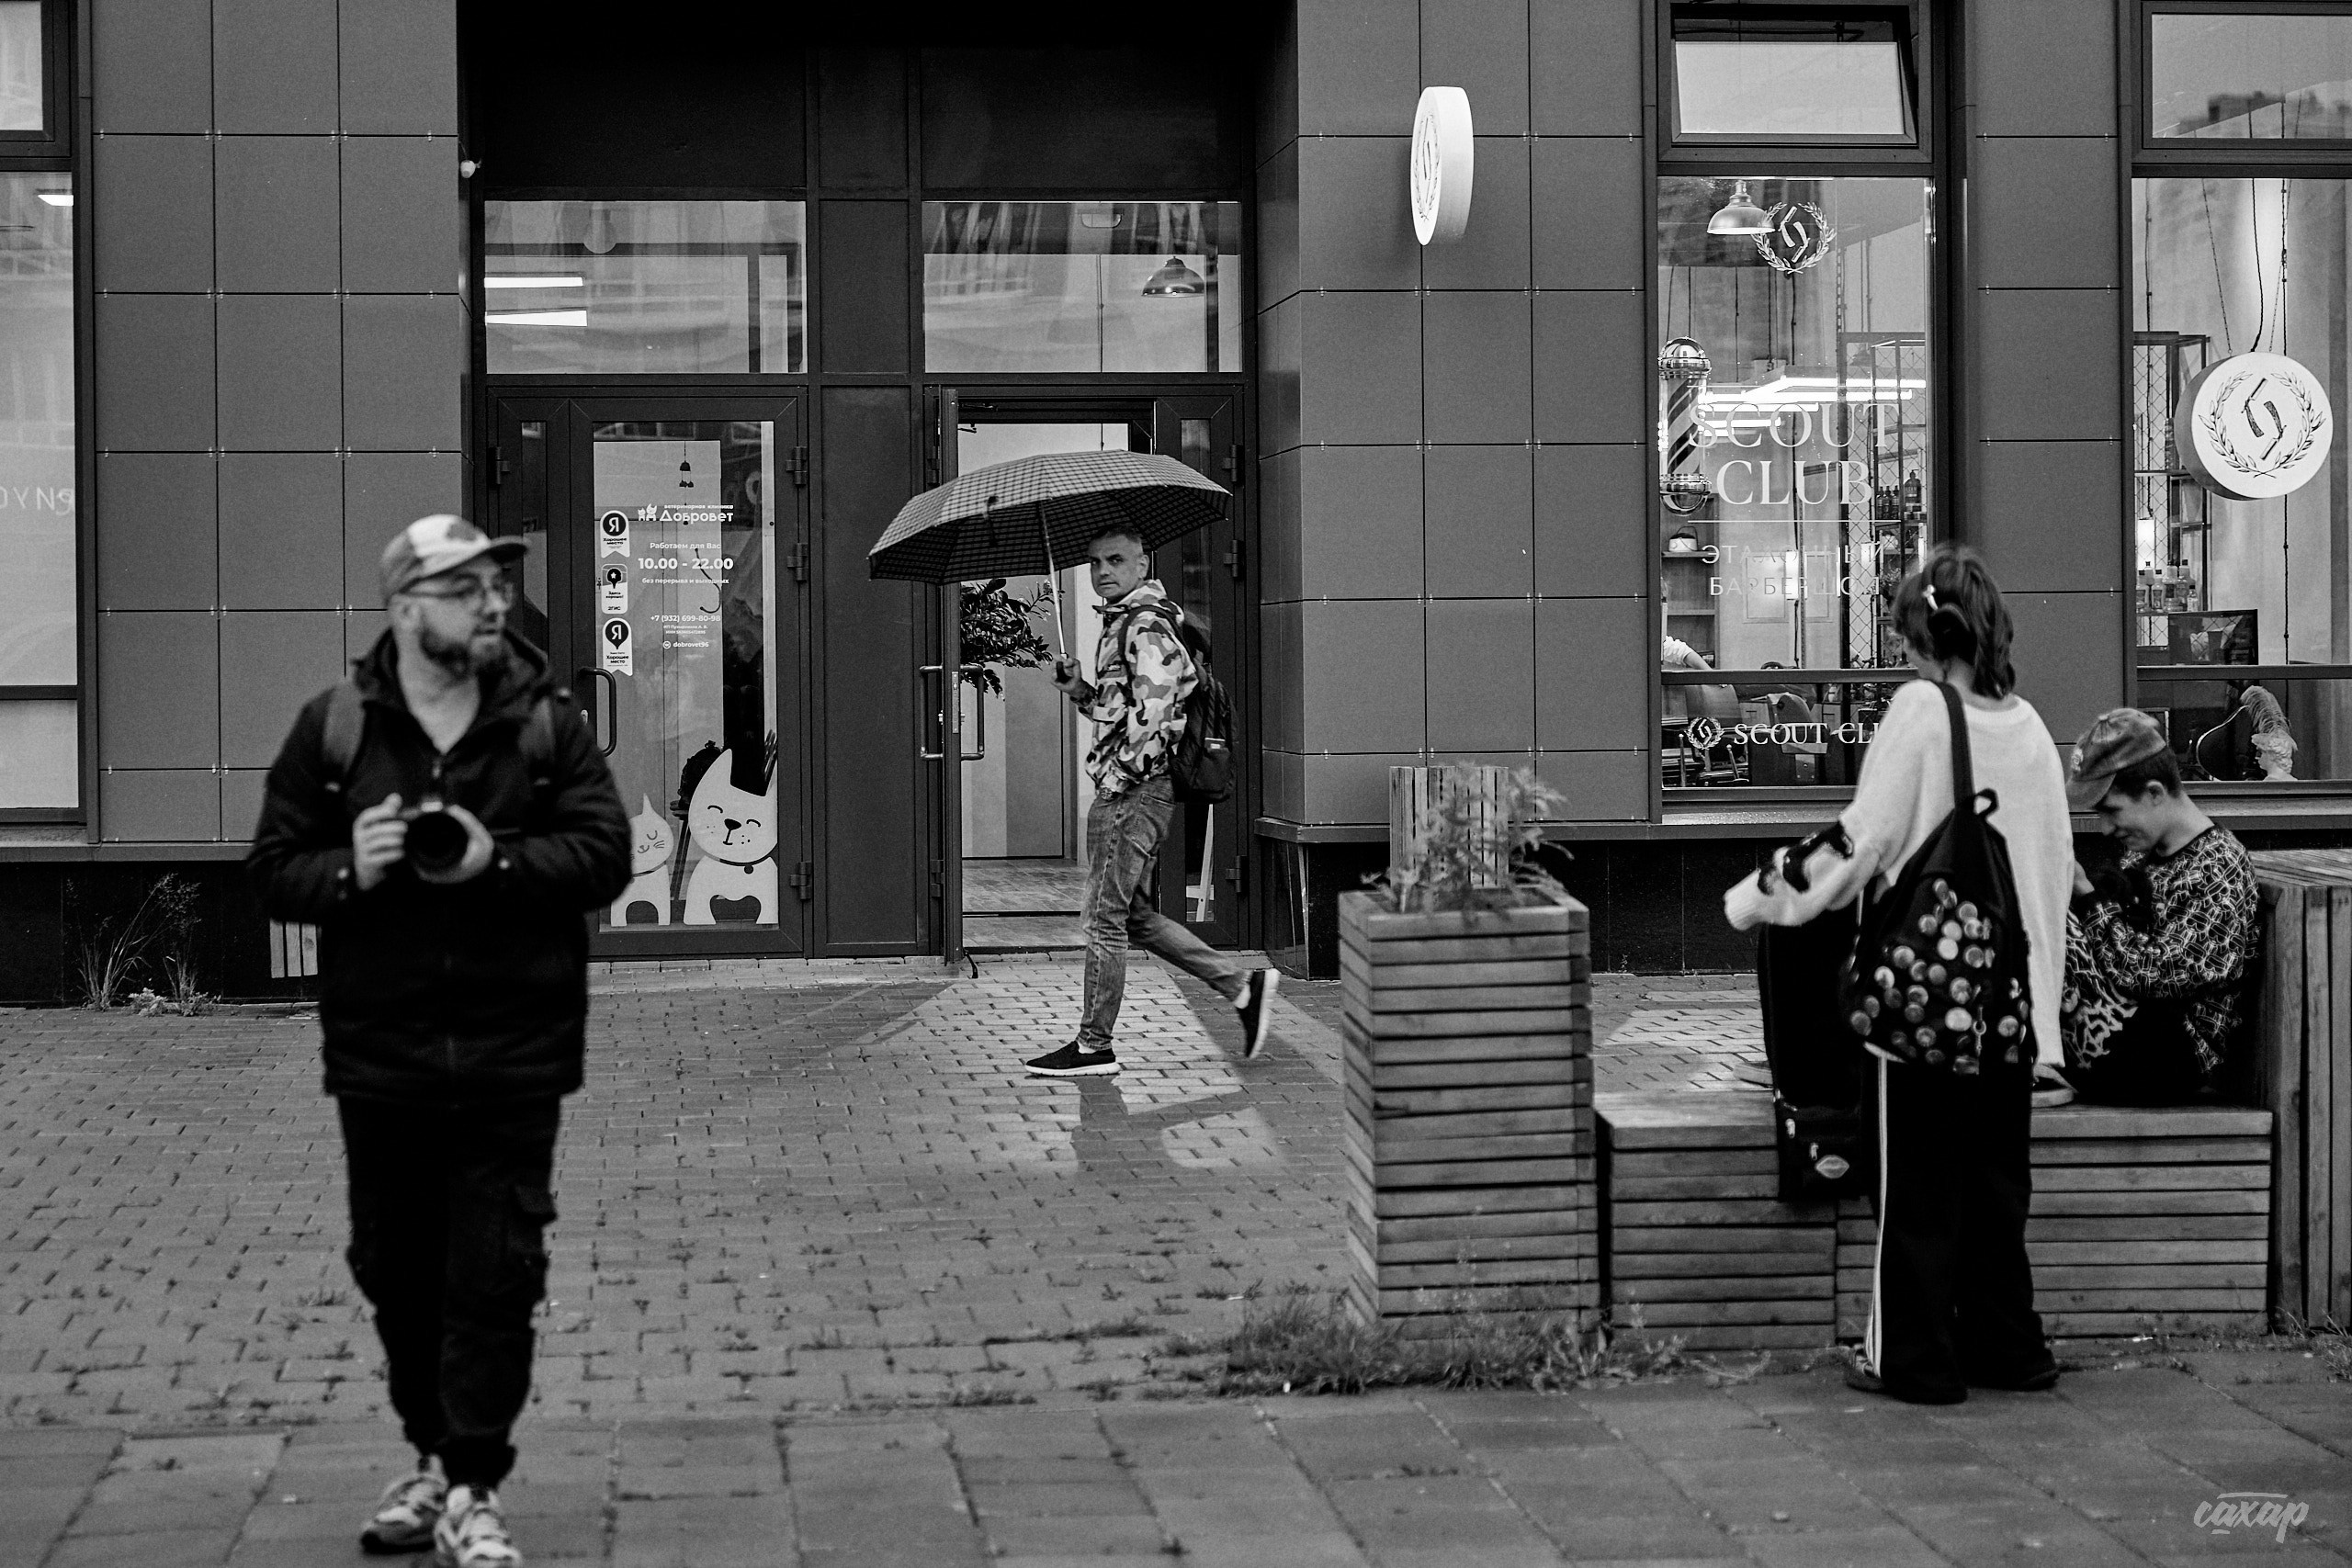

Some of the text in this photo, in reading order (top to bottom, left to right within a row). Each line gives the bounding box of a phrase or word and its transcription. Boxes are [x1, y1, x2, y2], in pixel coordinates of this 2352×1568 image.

[1689, 403, 1900, 447] SCOUT
[1716, 460, 1872, 504] CLUB
[609, 517, 619, 532] Я
[659, 510, 734, 524] Добровет
[638, 558, 678, 570] 10.00
[692, 558, 734, 570] 22.00
[662, 615, 680, 623] (932)
[611, 625, 622, 640] Я
[1734, 723, 1880, 745] SCOUT CL
